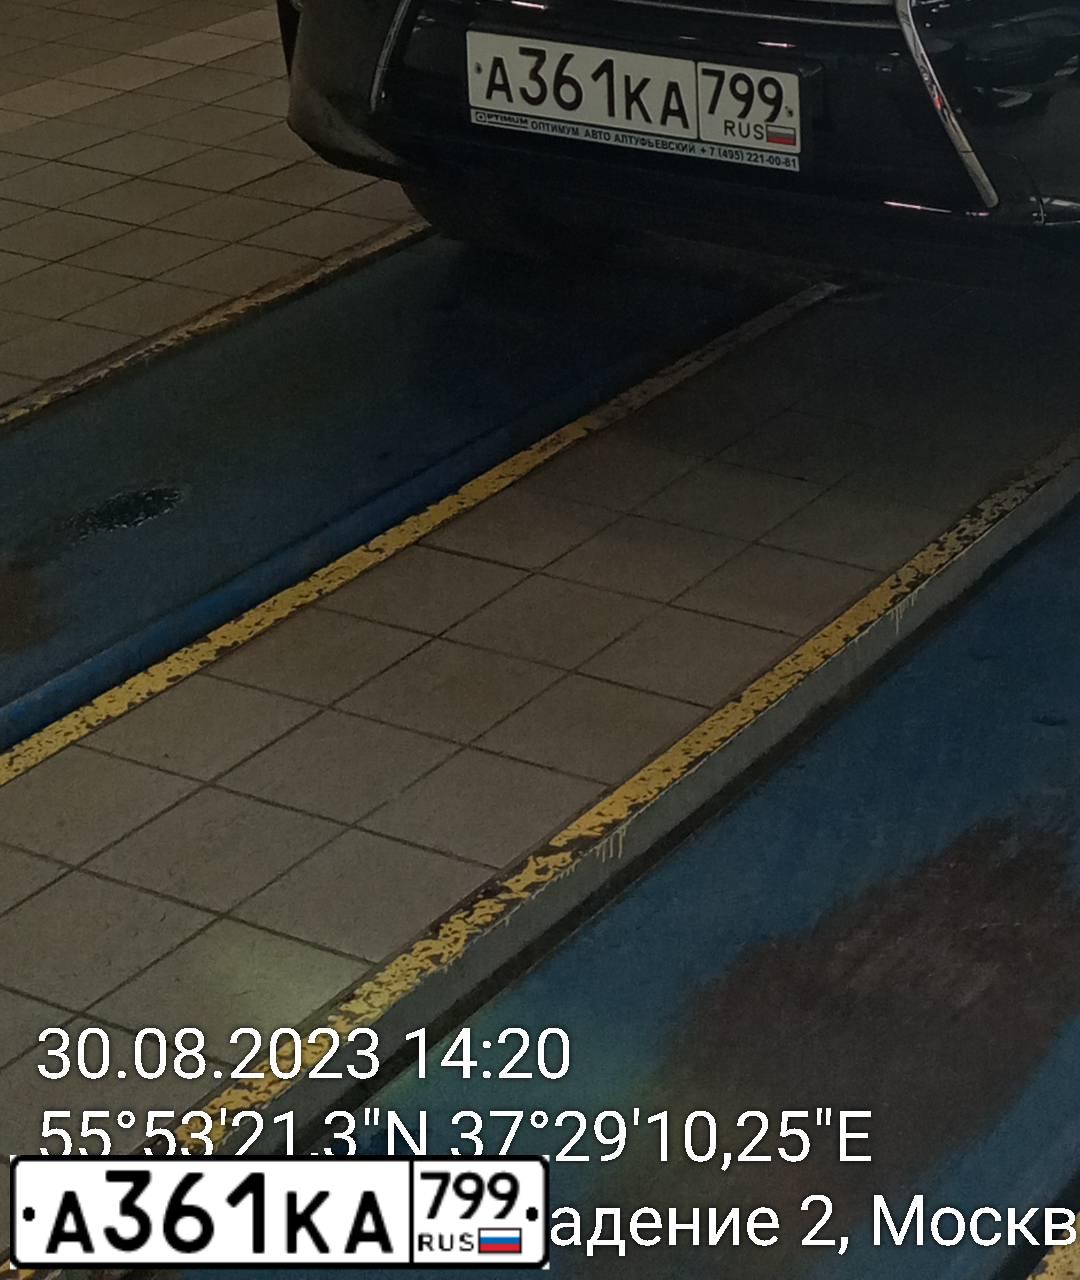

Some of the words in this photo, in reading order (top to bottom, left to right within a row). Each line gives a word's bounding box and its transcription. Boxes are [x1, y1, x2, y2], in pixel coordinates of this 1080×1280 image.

[485, 46, 690, 130] А361КА
[702, 68, 785, 124] 799
[530, 120, 580, 137] ОПТИМУМ
[583, 128, 611, 142] АВТО
[723, 119, 765, 141] RUS
